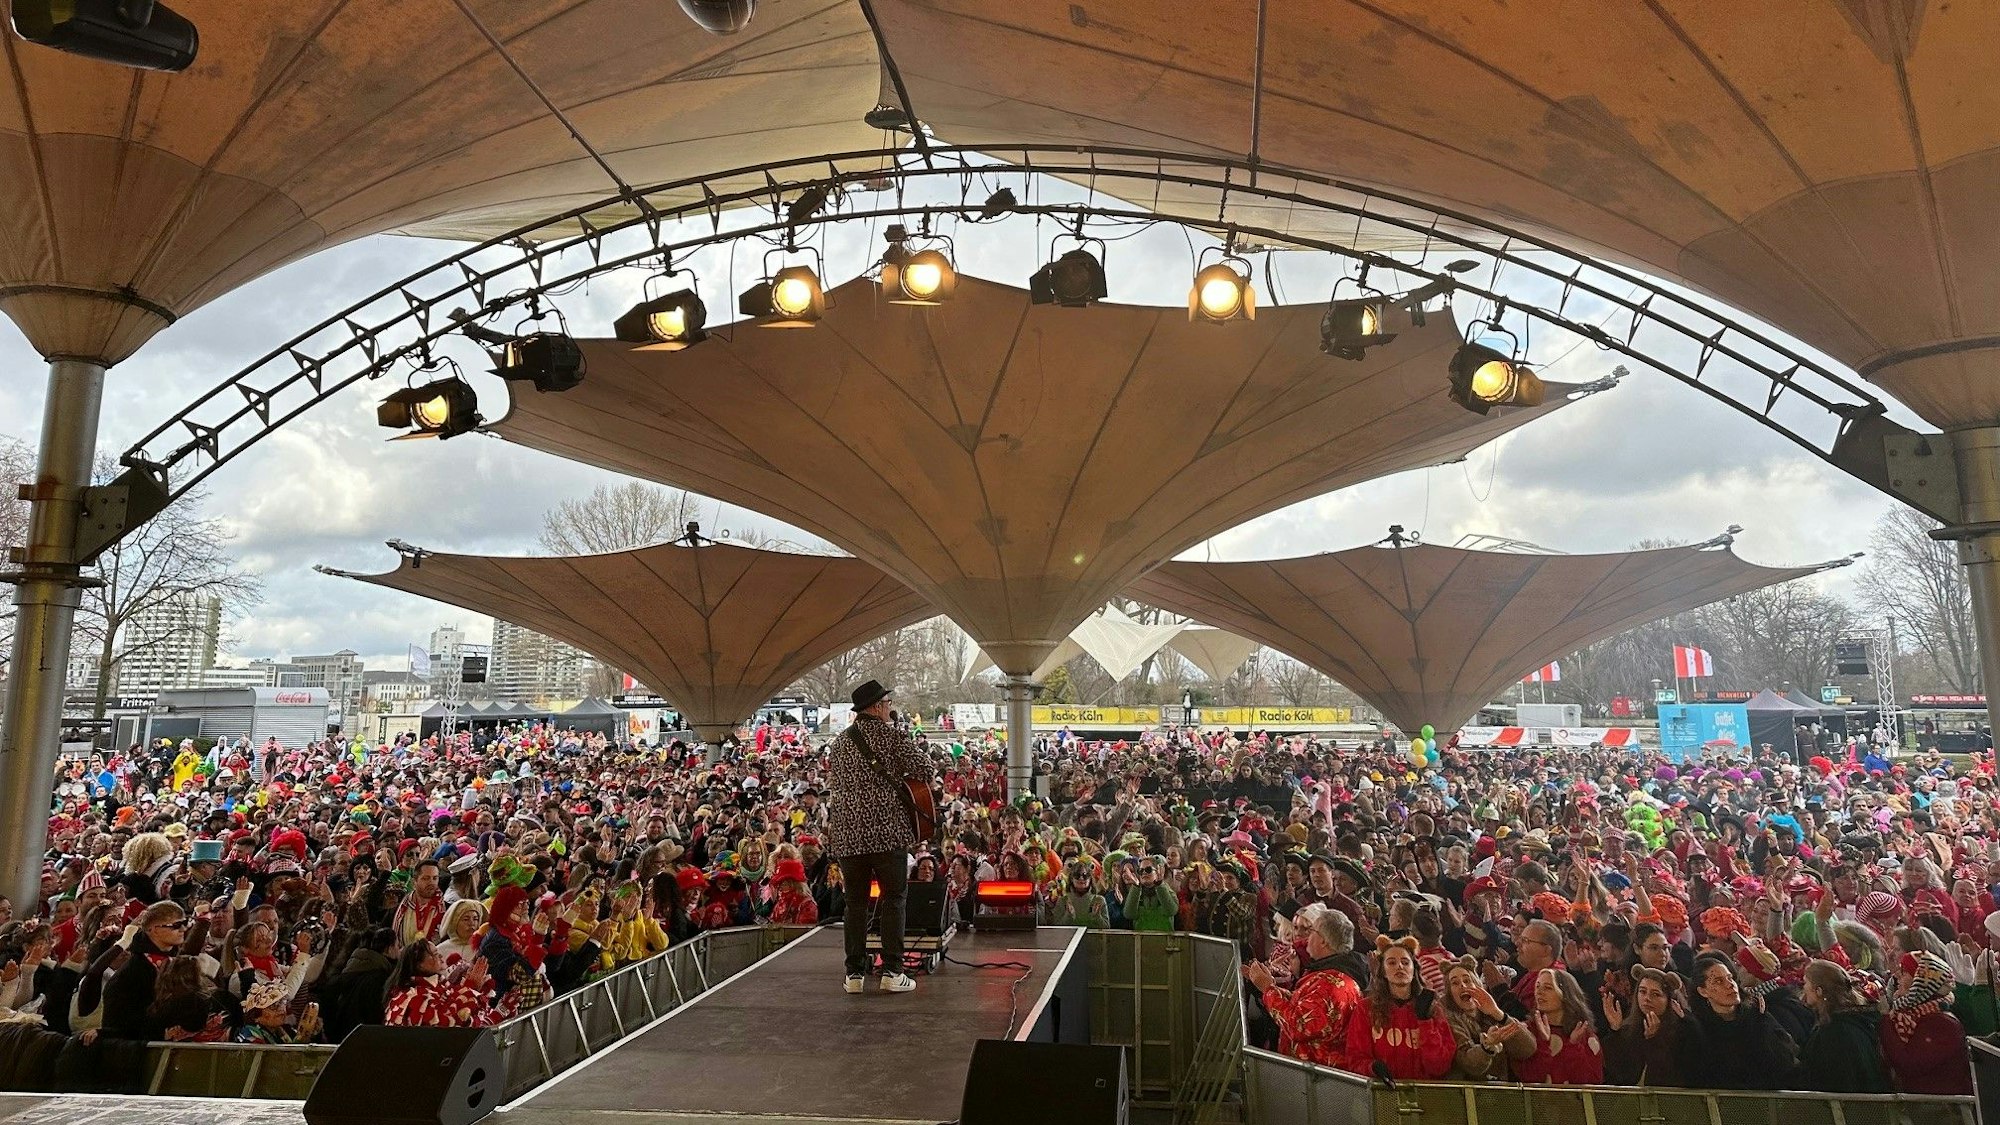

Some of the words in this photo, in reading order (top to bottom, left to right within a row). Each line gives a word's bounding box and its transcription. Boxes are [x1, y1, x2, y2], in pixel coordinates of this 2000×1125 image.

[120, 698, 155, 708] Fritten
[1051, 710, 1076, 721] Radio
[1079, 710, 1103, 721] Köln
[1259, 710, 1291, 721] Radio
[1294, 709, 1314, 721] Köln
